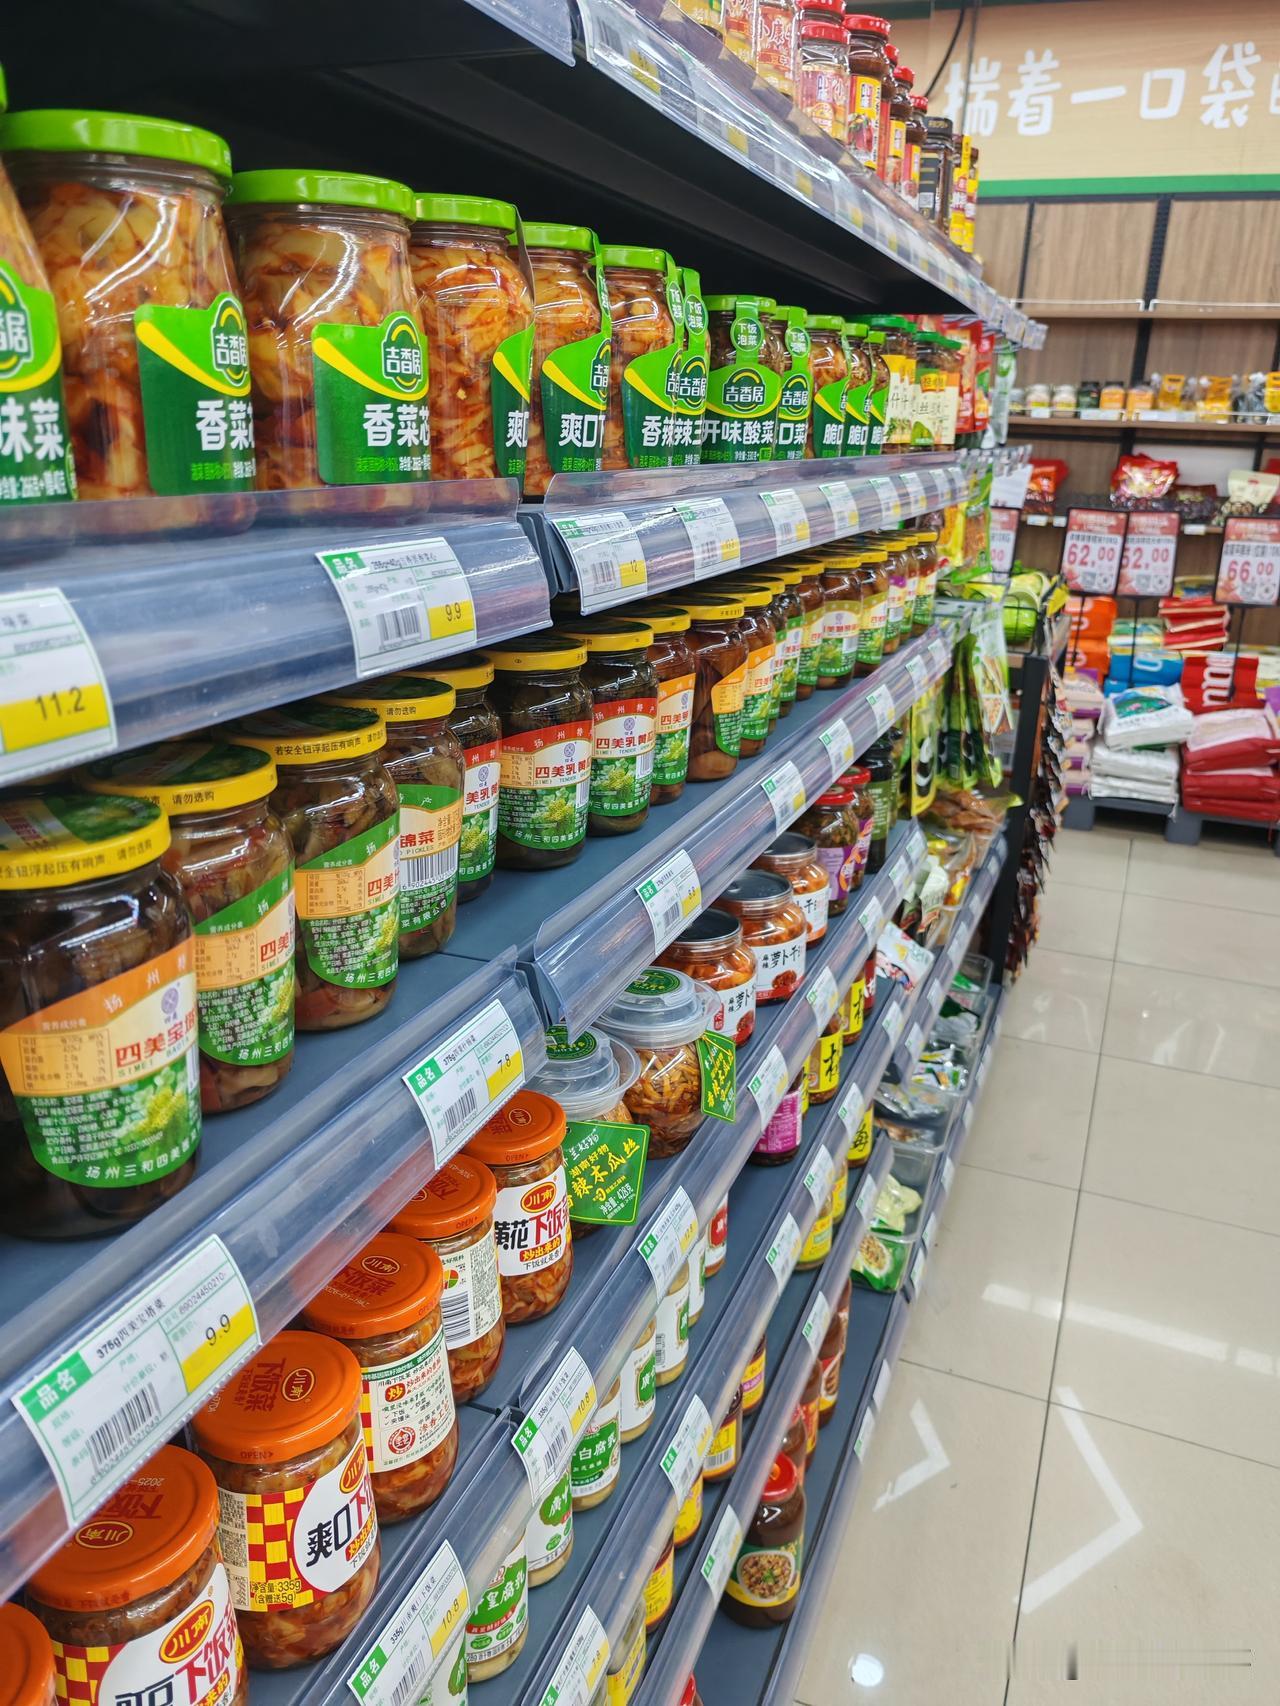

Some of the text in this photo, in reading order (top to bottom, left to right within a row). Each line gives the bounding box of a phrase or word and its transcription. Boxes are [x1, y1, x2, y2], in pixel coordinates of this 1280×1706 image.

[944, 41, 1280, 137] 揣着一口袋
[737, 334, 758, 346] 泡菜
[738, 323, 758, 335] 下饭
[386, 347, 421, 375] 吉香居
[725, 386, 764, 404] 吉香居
[195, 399, 255, 451] 香菜
[1066, 544, 1115, 568] 62.00
[1227, 559, 1274, 582] 66.00
[445, 602, 462, 622] 9.9
[35, 686, 86, 720] 11.2
[386, 706, 418, 717] 请勿选购
[275, 736, 362, 756] 若安全钮浮起压有响声
[171, 791, 216, 806] 请勿选购
[407, 844, 435, 855] PICKLES
[497, 1053, 512, 1074] 7.8
[416, 1066, 436, 1090] 品名
[569, 1143, 610, 1179] 湖南好物
[524, 1187, 555, 1211] 川南
[523, 1236, 561, 1261] 炒出来的
[365, 1256, 398, 1274] 川南
[97, 1297, 166, 1360] 375g四美宝塔菜
[205, 1313, 231, 1346] 9.9
[37, 1368, 76, 1410] 品名
[387, 1385, 405, 1402] 炒
[576, 1392, 591, 1414] 10.8
[518, 1427, 534, 1448] 品名
[102, 1493, 165, 1520] 下饭
[250, 1578, 302, 1594] 净含量:335g
[389, 1574, 438, 1646] 335g川南爽口下饭菜
[441, 1597, 461, 1630] 10.8
[169, 1613, 208, 1656] 川南
[361, 1660, 382, 1689] 品名
